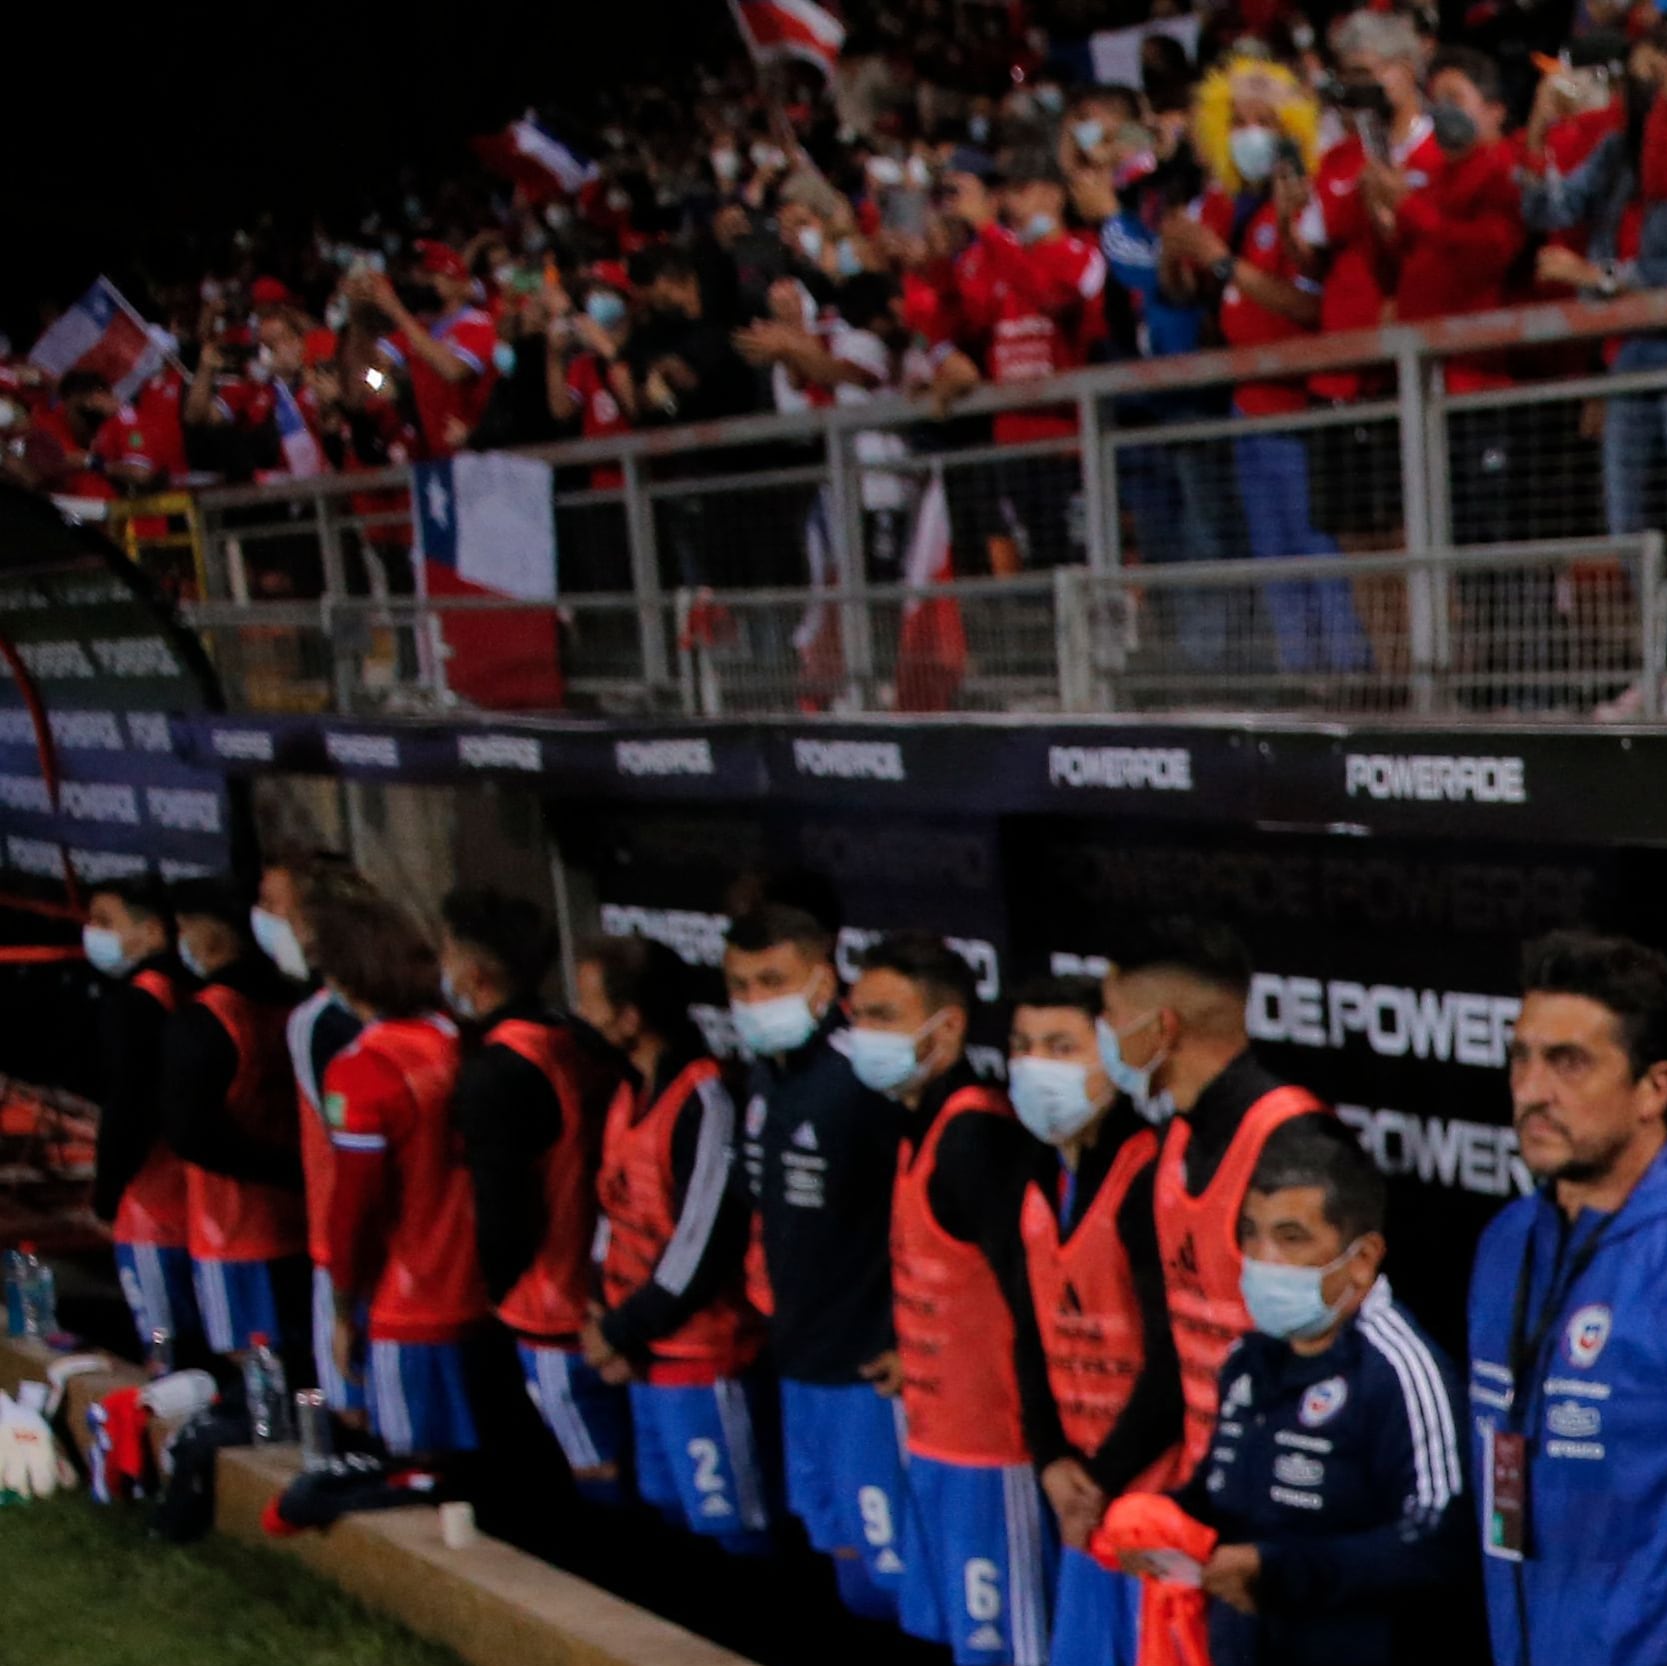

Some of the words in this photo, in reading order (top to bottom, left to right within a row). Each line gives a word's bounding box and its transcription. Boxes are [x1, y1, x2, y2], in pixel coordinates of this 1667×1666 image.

[1345, 754, 1527, 804] POWERADE
[1328, 979, 1522, 1069] POWER
[687, 1436, 725, 1492] 2
[857, 1485, 894, 1545] 9
[963, 1558, 1003, 1620] 6
